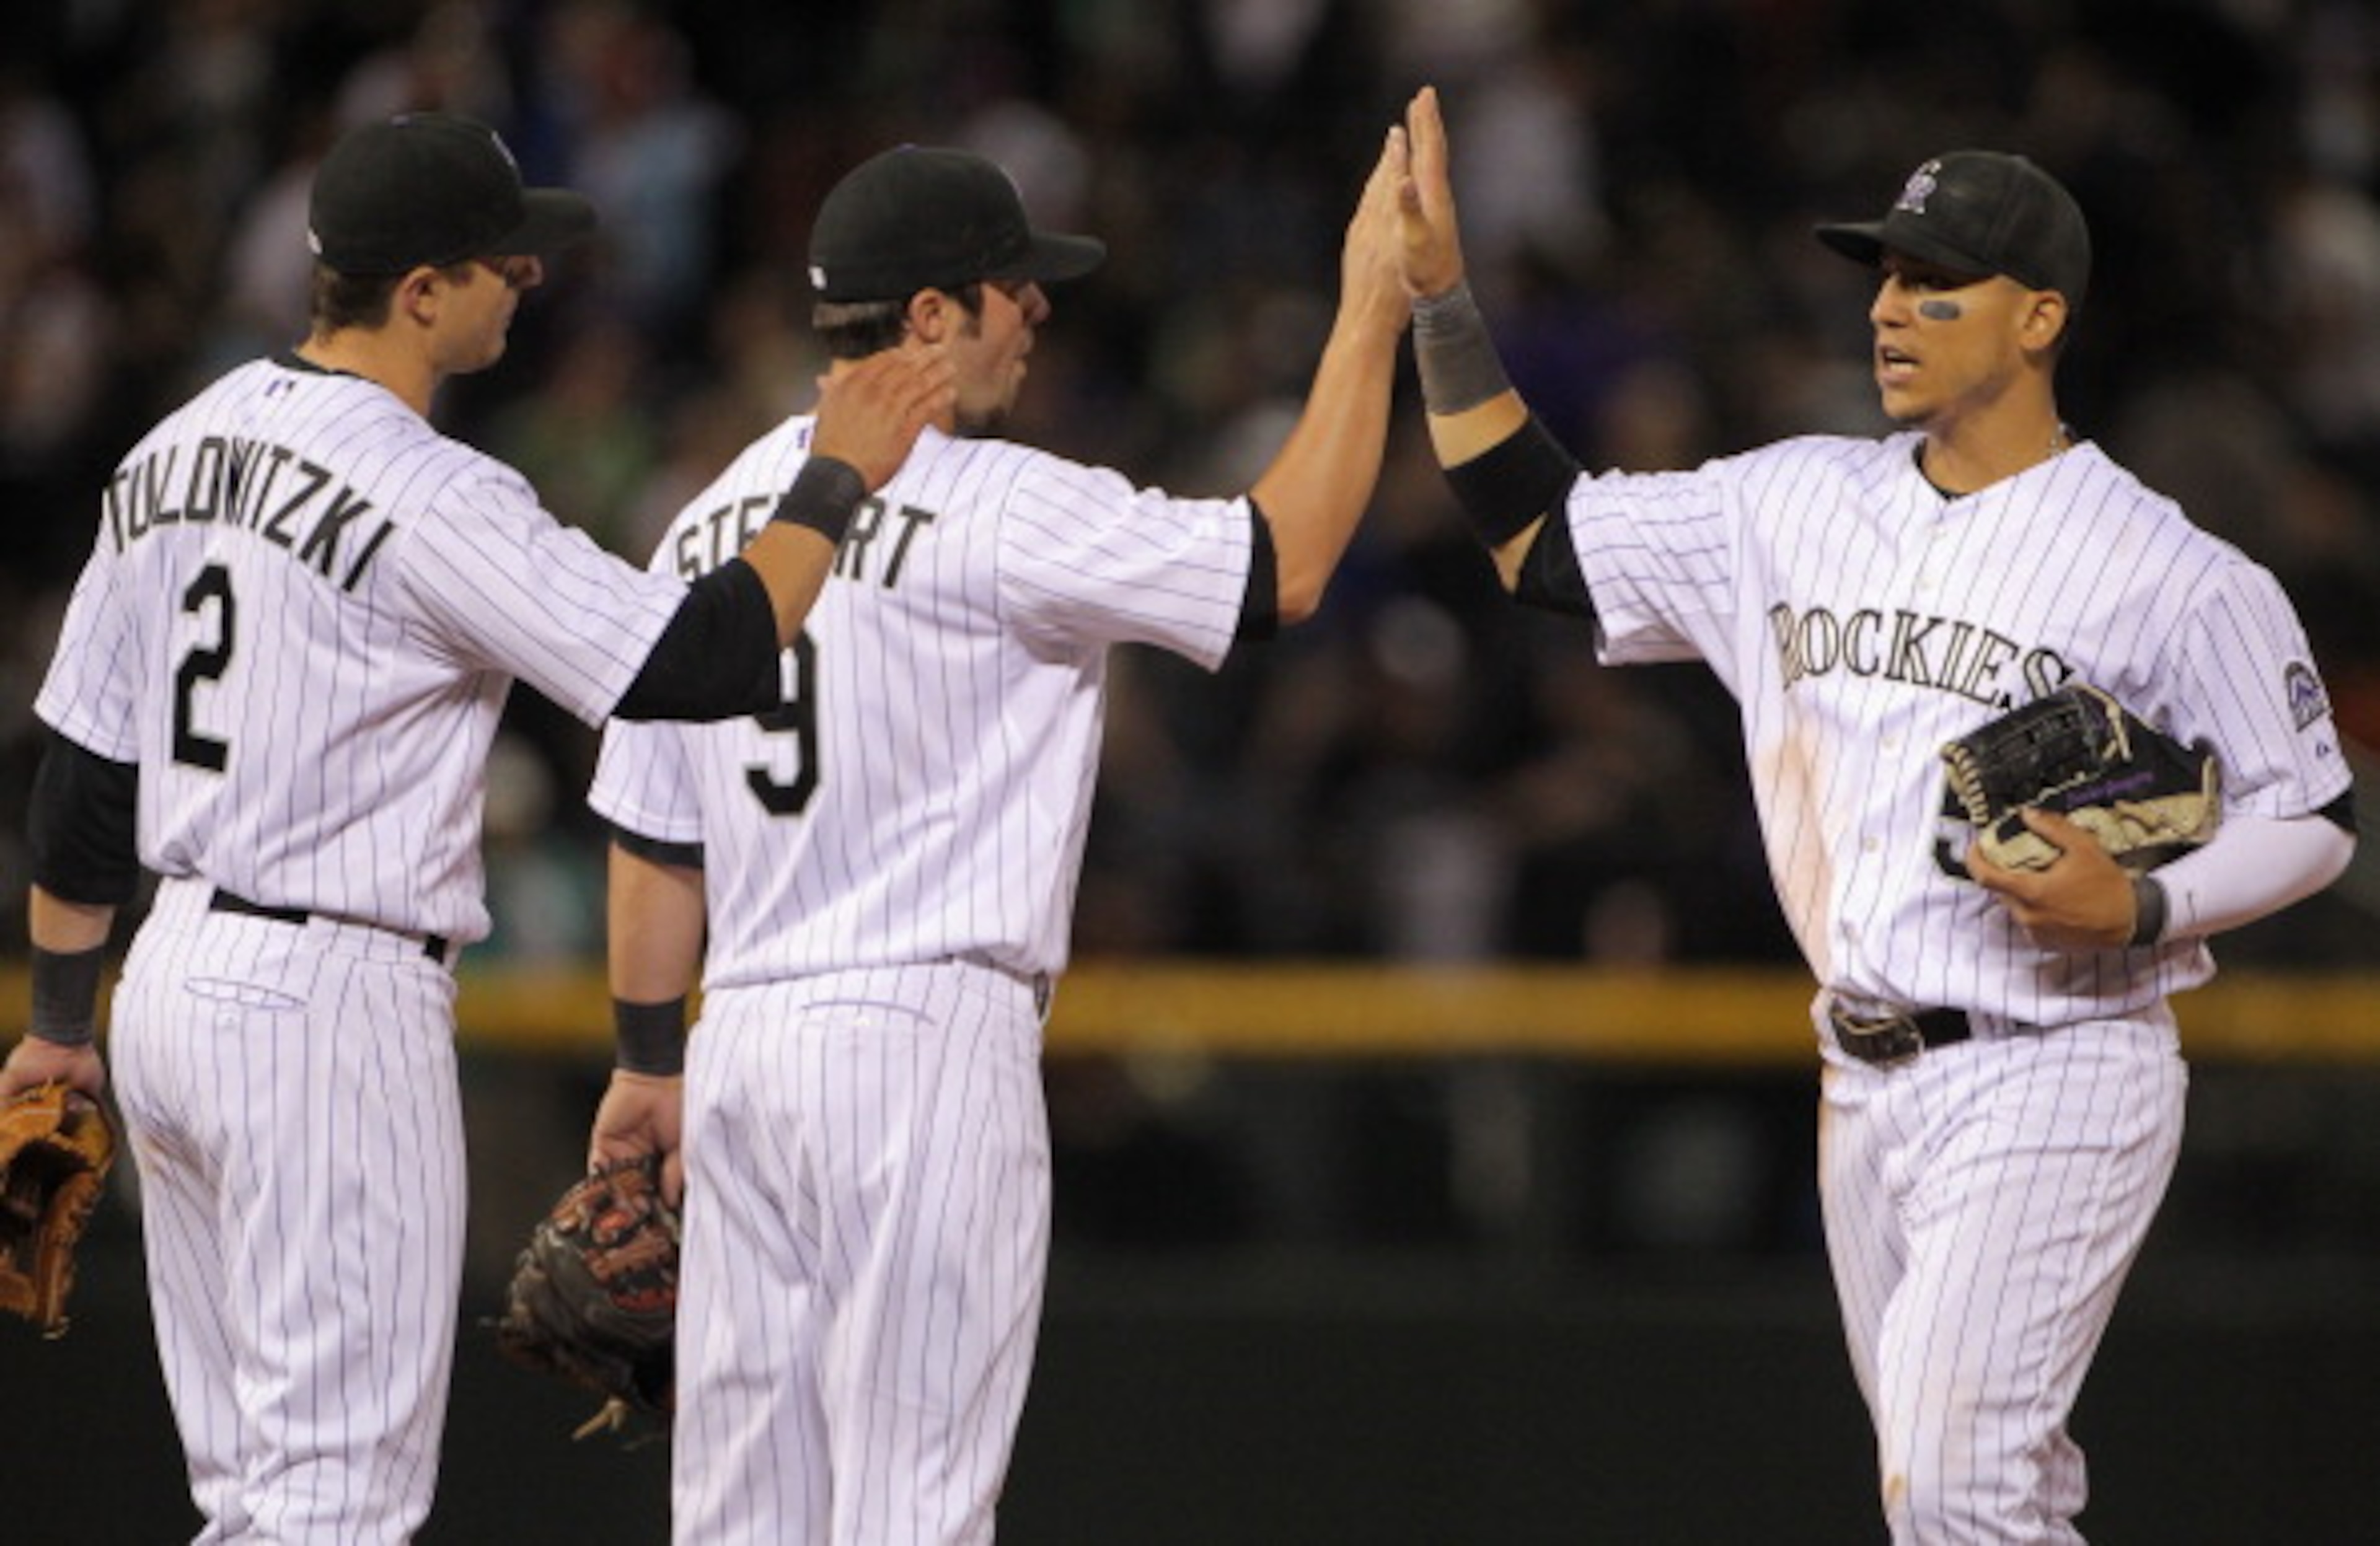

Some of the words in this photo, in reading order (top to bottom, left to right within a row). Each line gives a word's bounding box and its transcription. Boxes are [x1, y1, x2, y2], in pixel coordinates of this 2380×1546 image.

[674, 493, 935, 589] STERT
[172, 558, 236, 773] 2
[746, 625, 819, 817] 9
